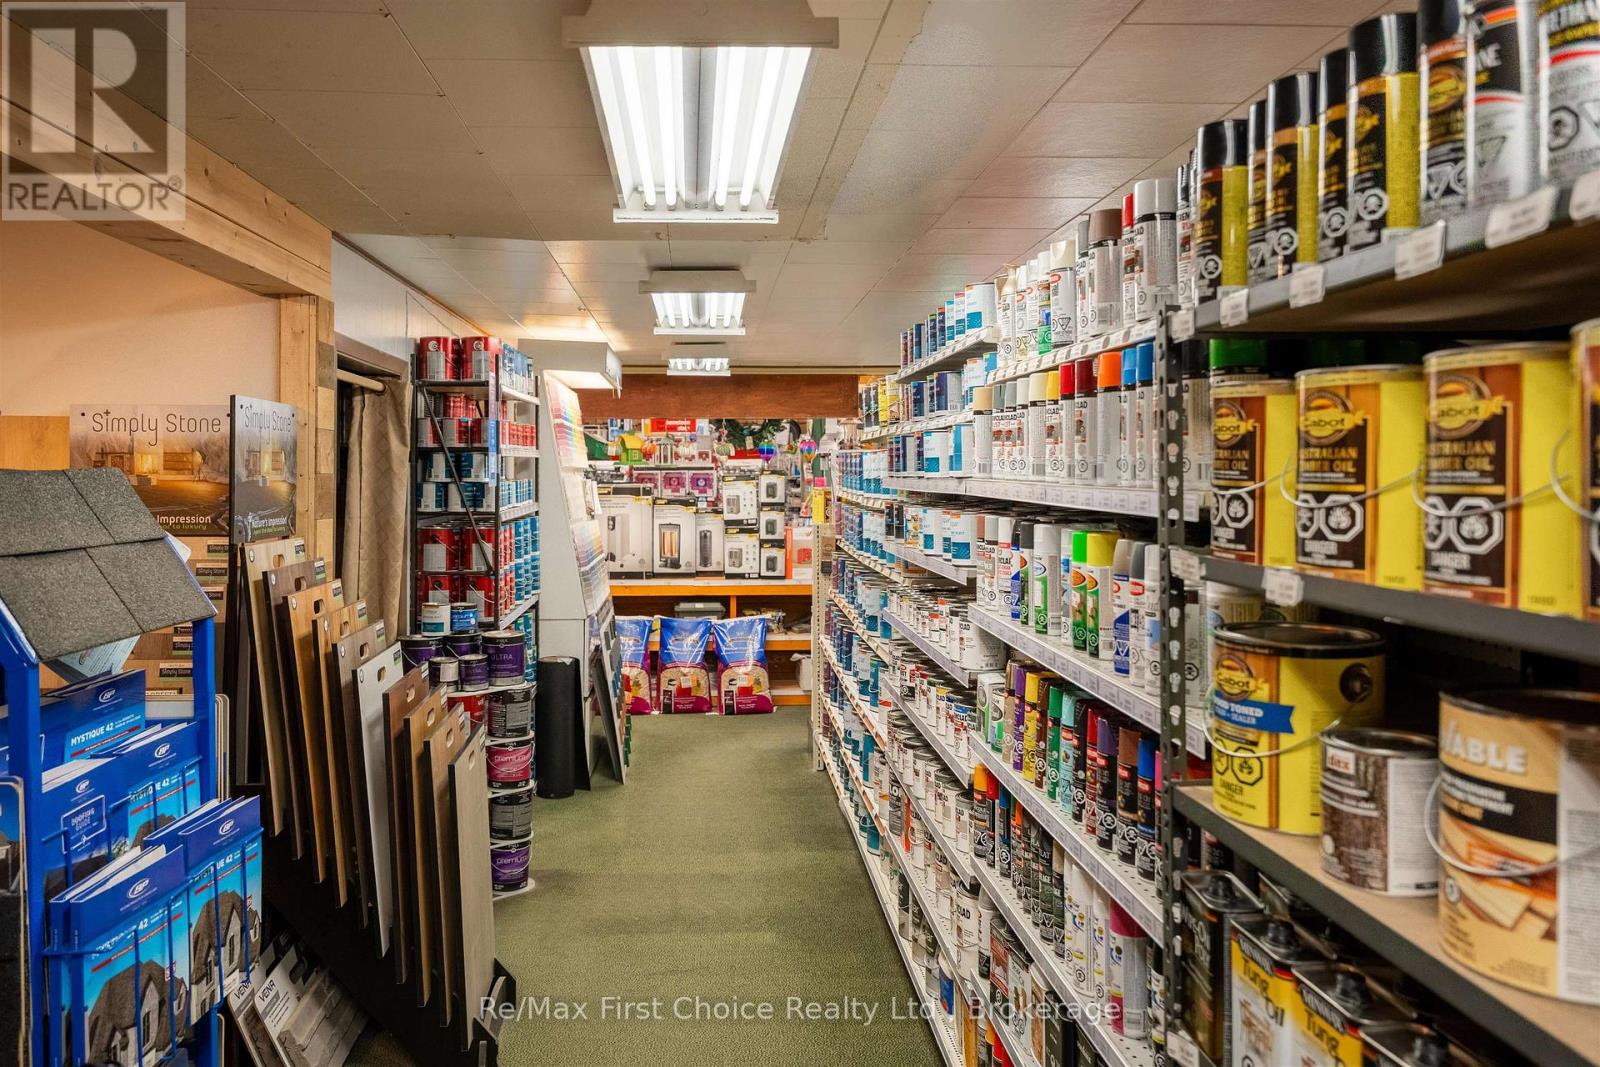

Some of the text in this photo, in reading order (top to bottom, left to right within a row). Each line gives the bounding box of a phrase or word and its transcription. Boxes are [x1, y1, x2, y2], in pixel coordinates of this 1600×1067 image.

[92, 409, 221, 446] Simply Stone
[244, 404, 291, 445] Simply Stone
[157, 514, 212, 527] Impression
[70, 722, 114, 747] MYSTIQUE 42
[161, 777, 170, 788] 42
[225, 855, 233, 865] 42
[138, 917, 149, 930] 42
